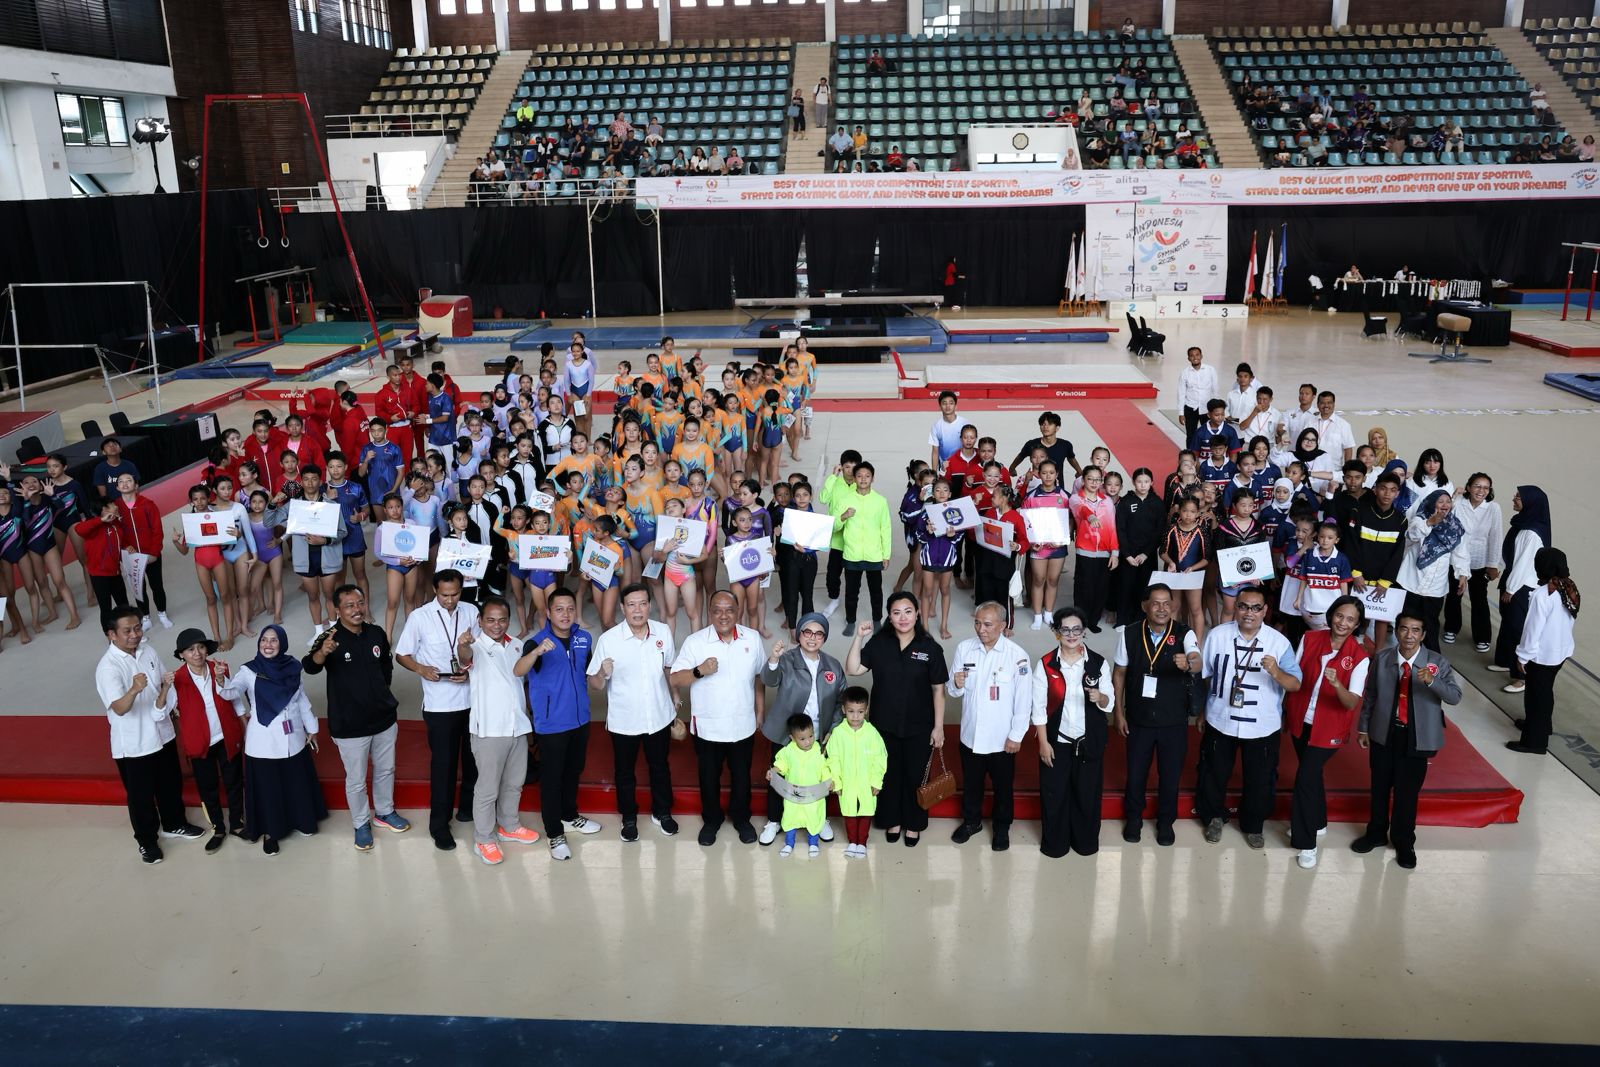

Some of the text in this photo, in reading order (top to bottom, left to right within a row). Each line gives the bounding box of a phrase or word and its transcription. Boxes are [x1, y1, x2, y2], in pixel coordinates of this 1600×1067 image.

[1115, 176, 1139, 184] alita
[1280, 176, 1303, 184] BEST
[1305, 176, 1316, 184] OF
[1318, 176, 1342, 184] LUCK
[1356, 175, 1382, 184] YOUR
[1456, 172, 1479, 180] STAY
[774, 180, 797, 188] BEST
[800, 180, 811, 188] OF
[813, 180, 836, 188] LUCK
[850, 180, 874, 188] YOUR
[947, 179, 970, 188] STAY
[1245, 187, 1279, 196] STRIVE
[1281, 187, 1299, 195] FOR
[1302, 186, 1344, 195] OLYMPIC
[1381, 185, 1400, 193] AND
[1437, 184, 1460, 192] GIVE
[1462, 183, 1475, 191] UP
[1478, 182, 1491, 191] ON
[1493, 182, 1520, 190] YOUR
[740, 191, 774, 200] STRIVE
[776, 191, 794, 200] FOR
[796, 191, 836, 199] OLYMPIC
[873, 190, 893, 199] AND
[928, 190, 950, 198] GIVE
[952, 190, 965, 198] UP
[967, 190, 981, 198] ON
[983, 189, 1008, 198] YOUR
[1136, 218, 1183, 235] INDONESIA
[1138, 229, 1154, 242] OPEN
[1125, 284, 1152, 292] aita
[1128, 303, 1136, 312] 2
[1176, 301, 1181, 312] 1
[1222, 308, 1228, 317] 3
[1131, 504, 1138, 512] E
[455, 559, 473, 568] ICG
[741, 553, 759, 565] nika
